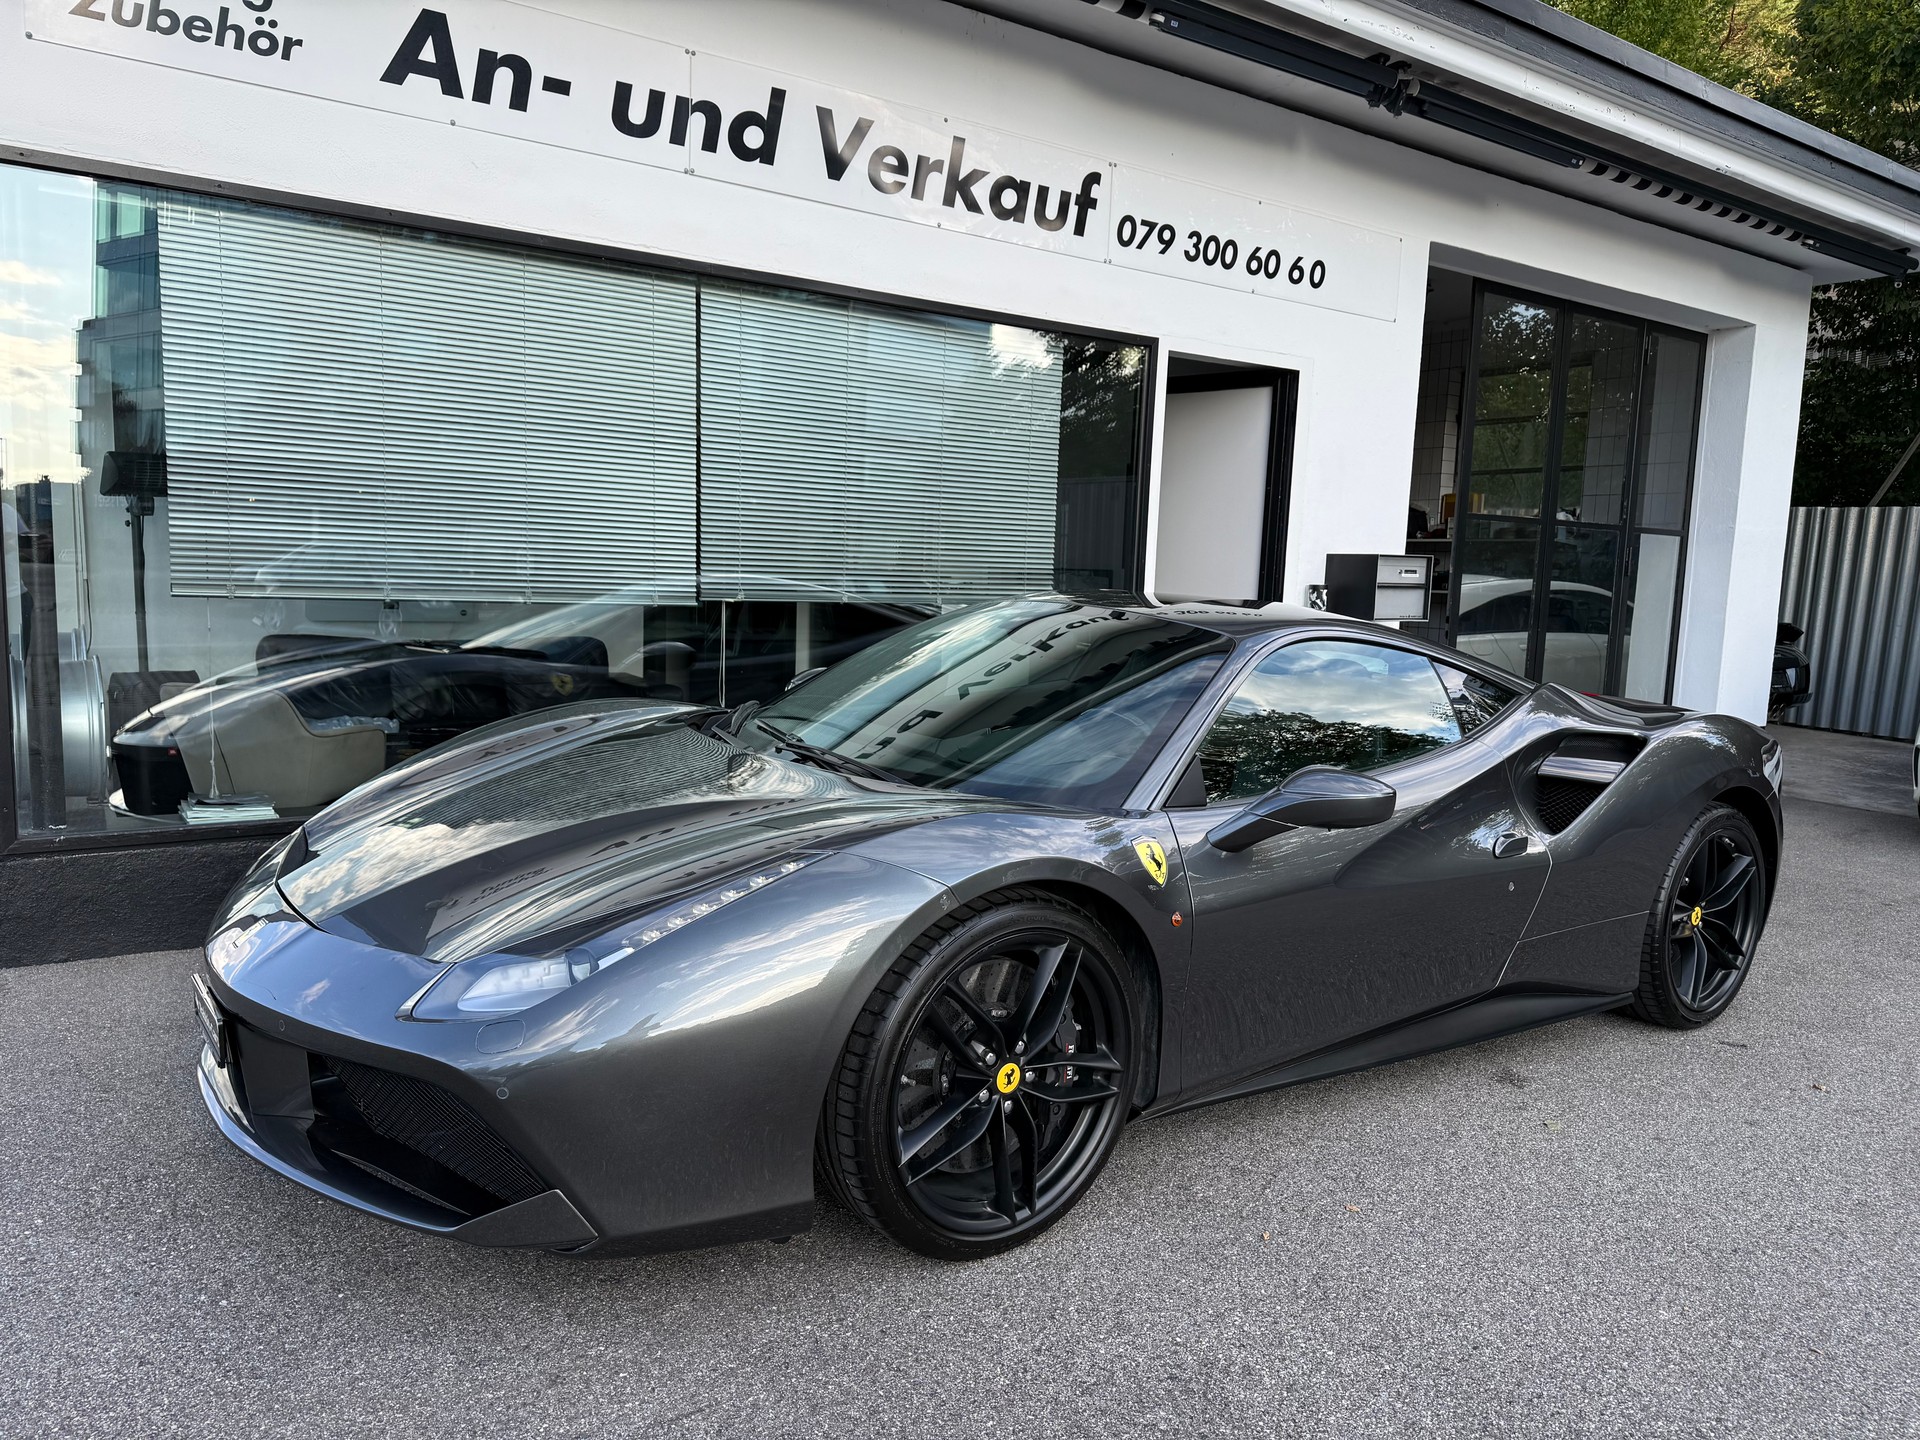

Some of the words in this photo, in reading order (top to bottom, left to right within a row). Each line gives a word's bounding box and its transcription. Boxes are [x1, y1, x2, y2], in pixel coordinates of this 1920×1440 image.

[379, 8, 572, 113] An-
[611, 80, 787, 166] und
[815, 105, 1102, 237] Verkauf
[1116, 214, 1176, 255] 079
[1183, 230, 1239, 270] 300
[1245, 246, 1281, 280] 60
[1288, 256, 1326, 289] 60
